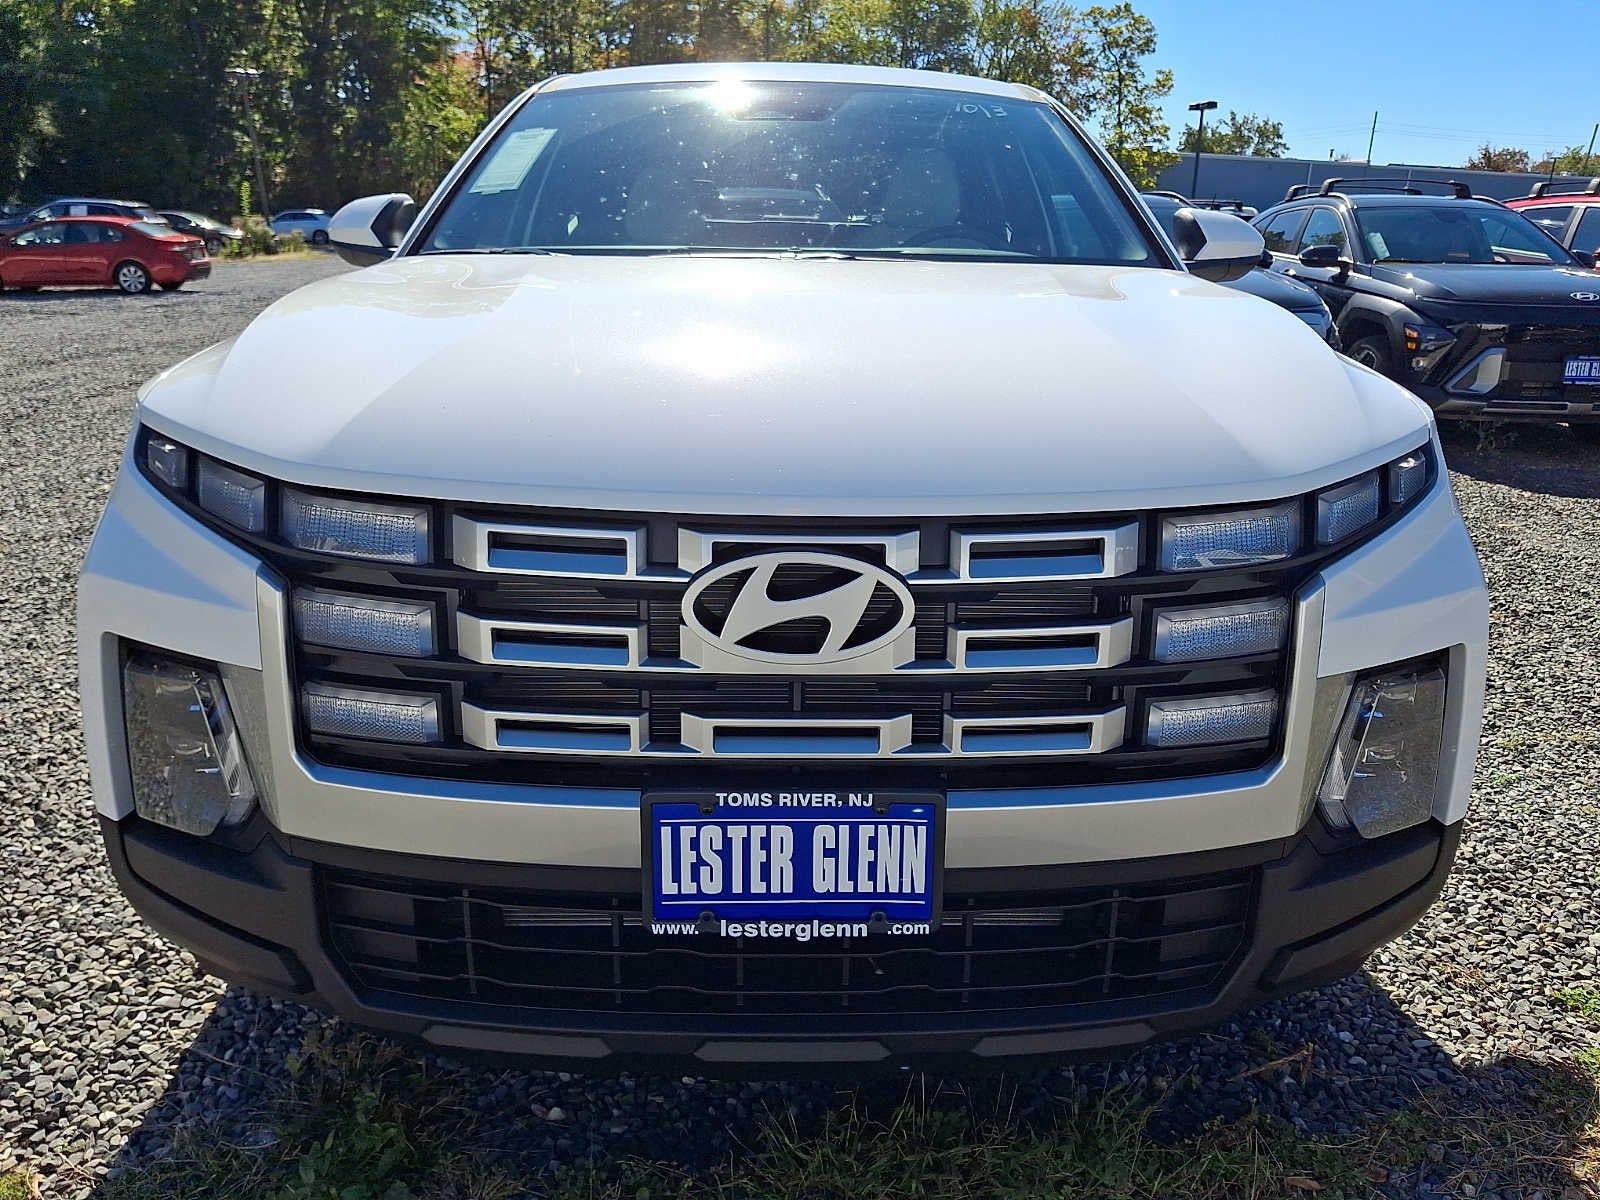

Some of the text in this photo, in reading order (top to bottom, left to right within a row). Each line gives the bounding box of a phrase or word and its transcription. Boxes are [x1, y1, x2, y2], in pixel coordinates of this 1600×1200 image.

[1565, 362, 1591, 377] LESTER
[715, 792, 874, 808] TOMS RIVER, NJ
[660, 824, 927, 895] LESTER GLENN
[651, 919, 930, 942] www. lesterglenn .com
